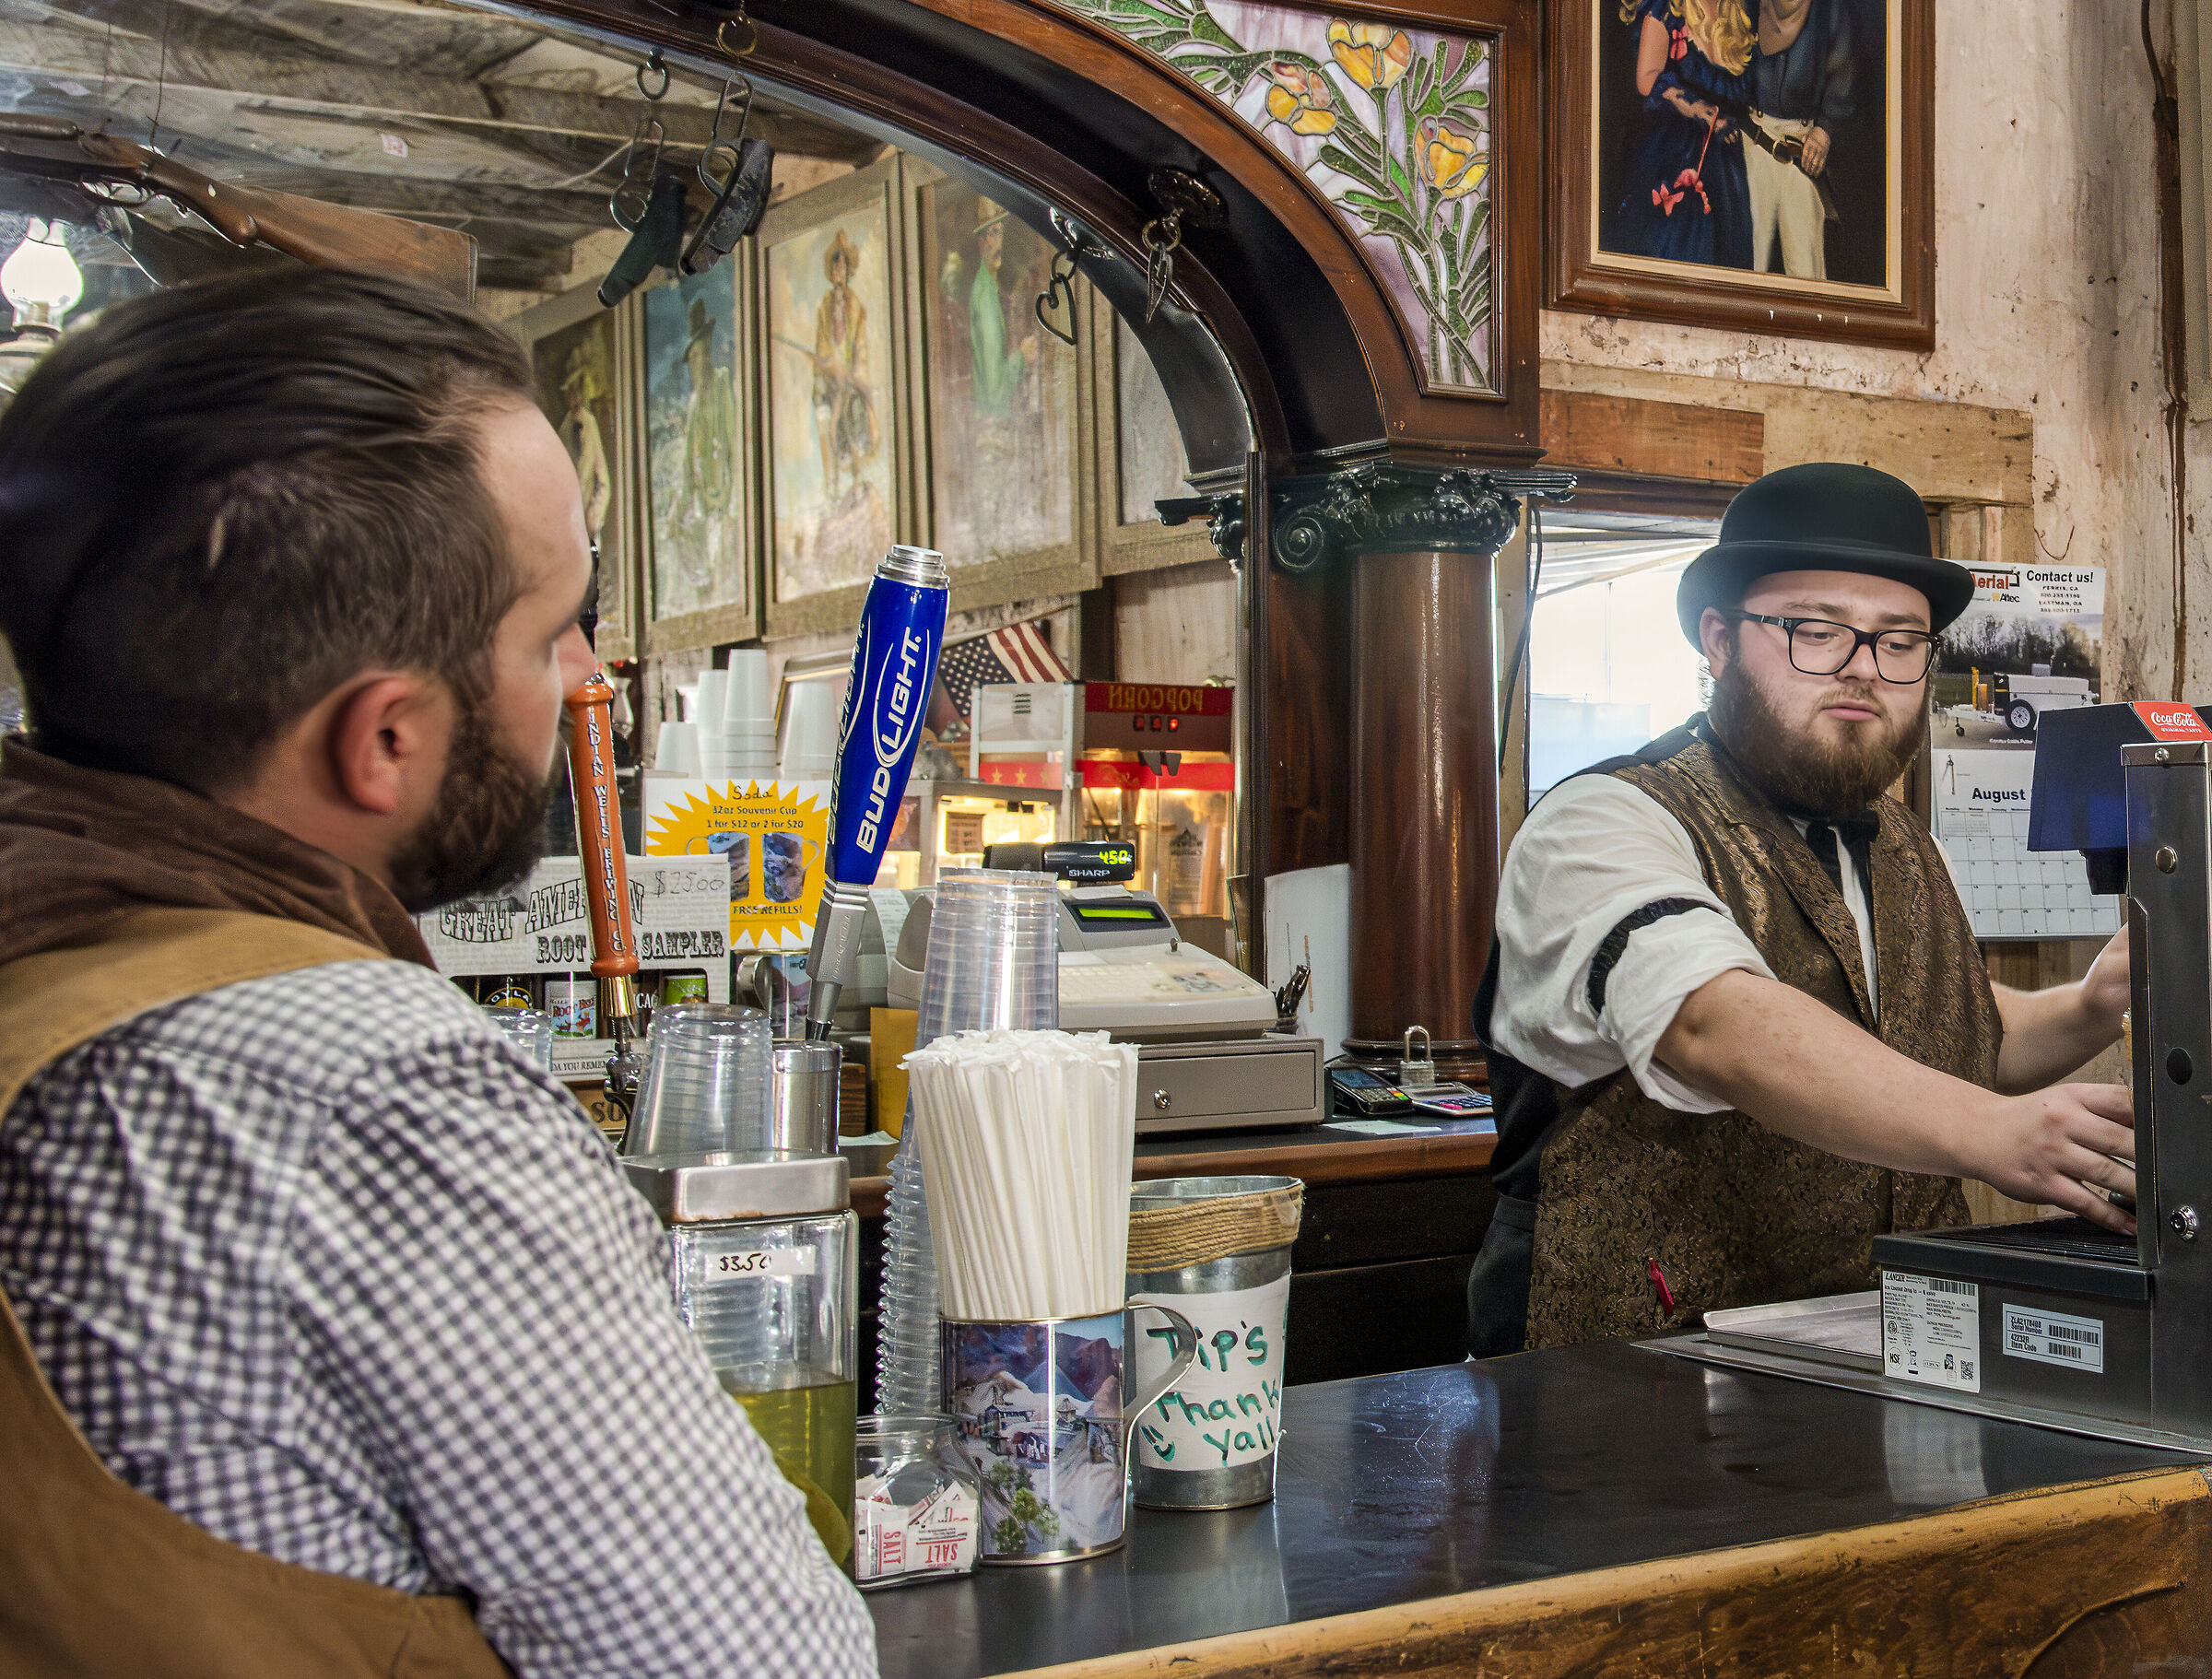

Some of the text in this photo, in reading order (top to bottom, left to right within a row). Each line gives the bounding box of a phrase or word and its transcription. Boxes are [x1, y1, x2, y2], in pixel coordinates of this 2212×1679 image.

[2027, 569, 2094, 583] Contact us!
[732, 785, 773, 801] Soda
[1971, 787, 2026, 803] August
[736, 805, 777, 815] Souvenir
[780, 805, 797, 816] Cup
[856, 766, 891, 855] BUD
[707, 819, 712, 828] 1
[714, 819, 728, 828] for
[731, 819, 747, 828] $12
[763, 819, 769, 828] 2
[771, 819, 784, 828] for
[787, 819, 804, 828] $20
[1068, 869, 1111, 877] SHARP
[535, 934, 588, 964] ROOT
[641, 930, 724, 959] SAMPLER
[883, 1531, 902, 1565] SALT
[924, 1543, 959, 1564] SALT
